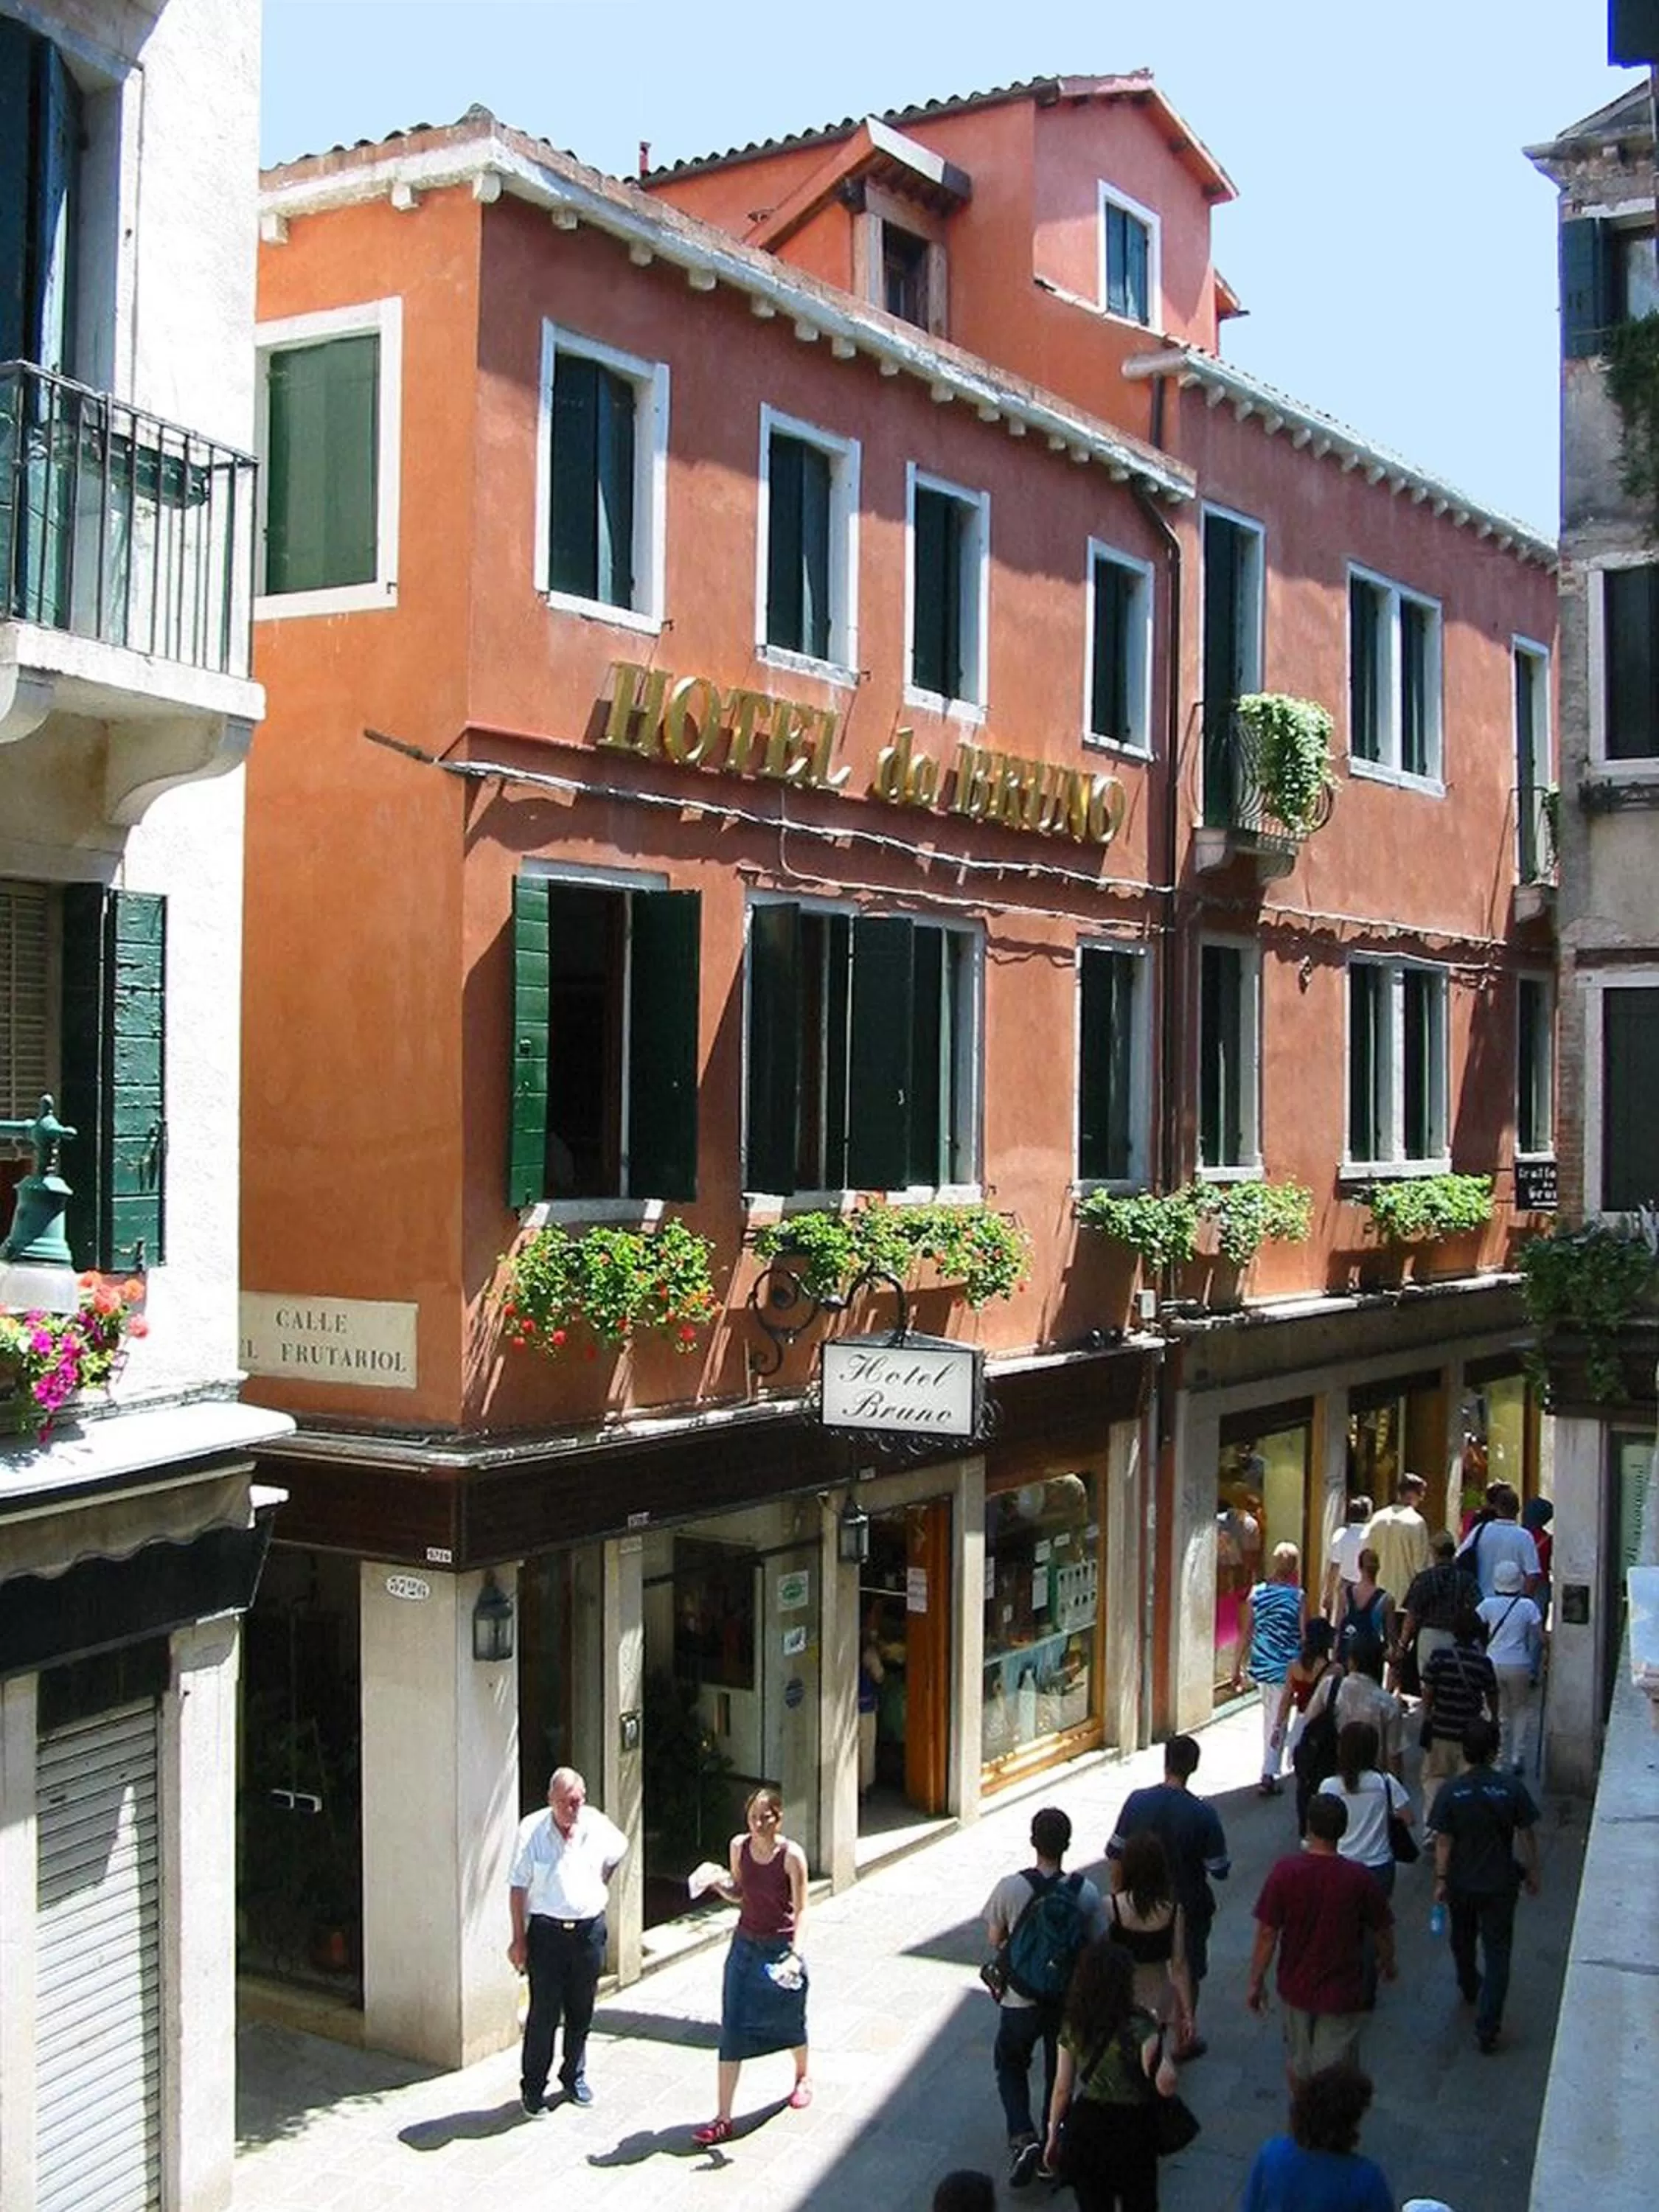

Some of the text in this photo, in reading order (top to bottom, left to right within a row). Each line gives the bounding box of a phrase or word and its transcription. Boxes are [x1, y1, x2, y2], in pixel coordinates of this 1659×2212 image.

[598, 662, 1126, 844] HOTEL da BRUNO
[275, 1309, 347, 1334] CALLE
[281, 1343, 406, 1372] FRUTARIOL
[839, 1353, 958, 1388] Hotel
[842, 1388, 953, 1424] Bruno
